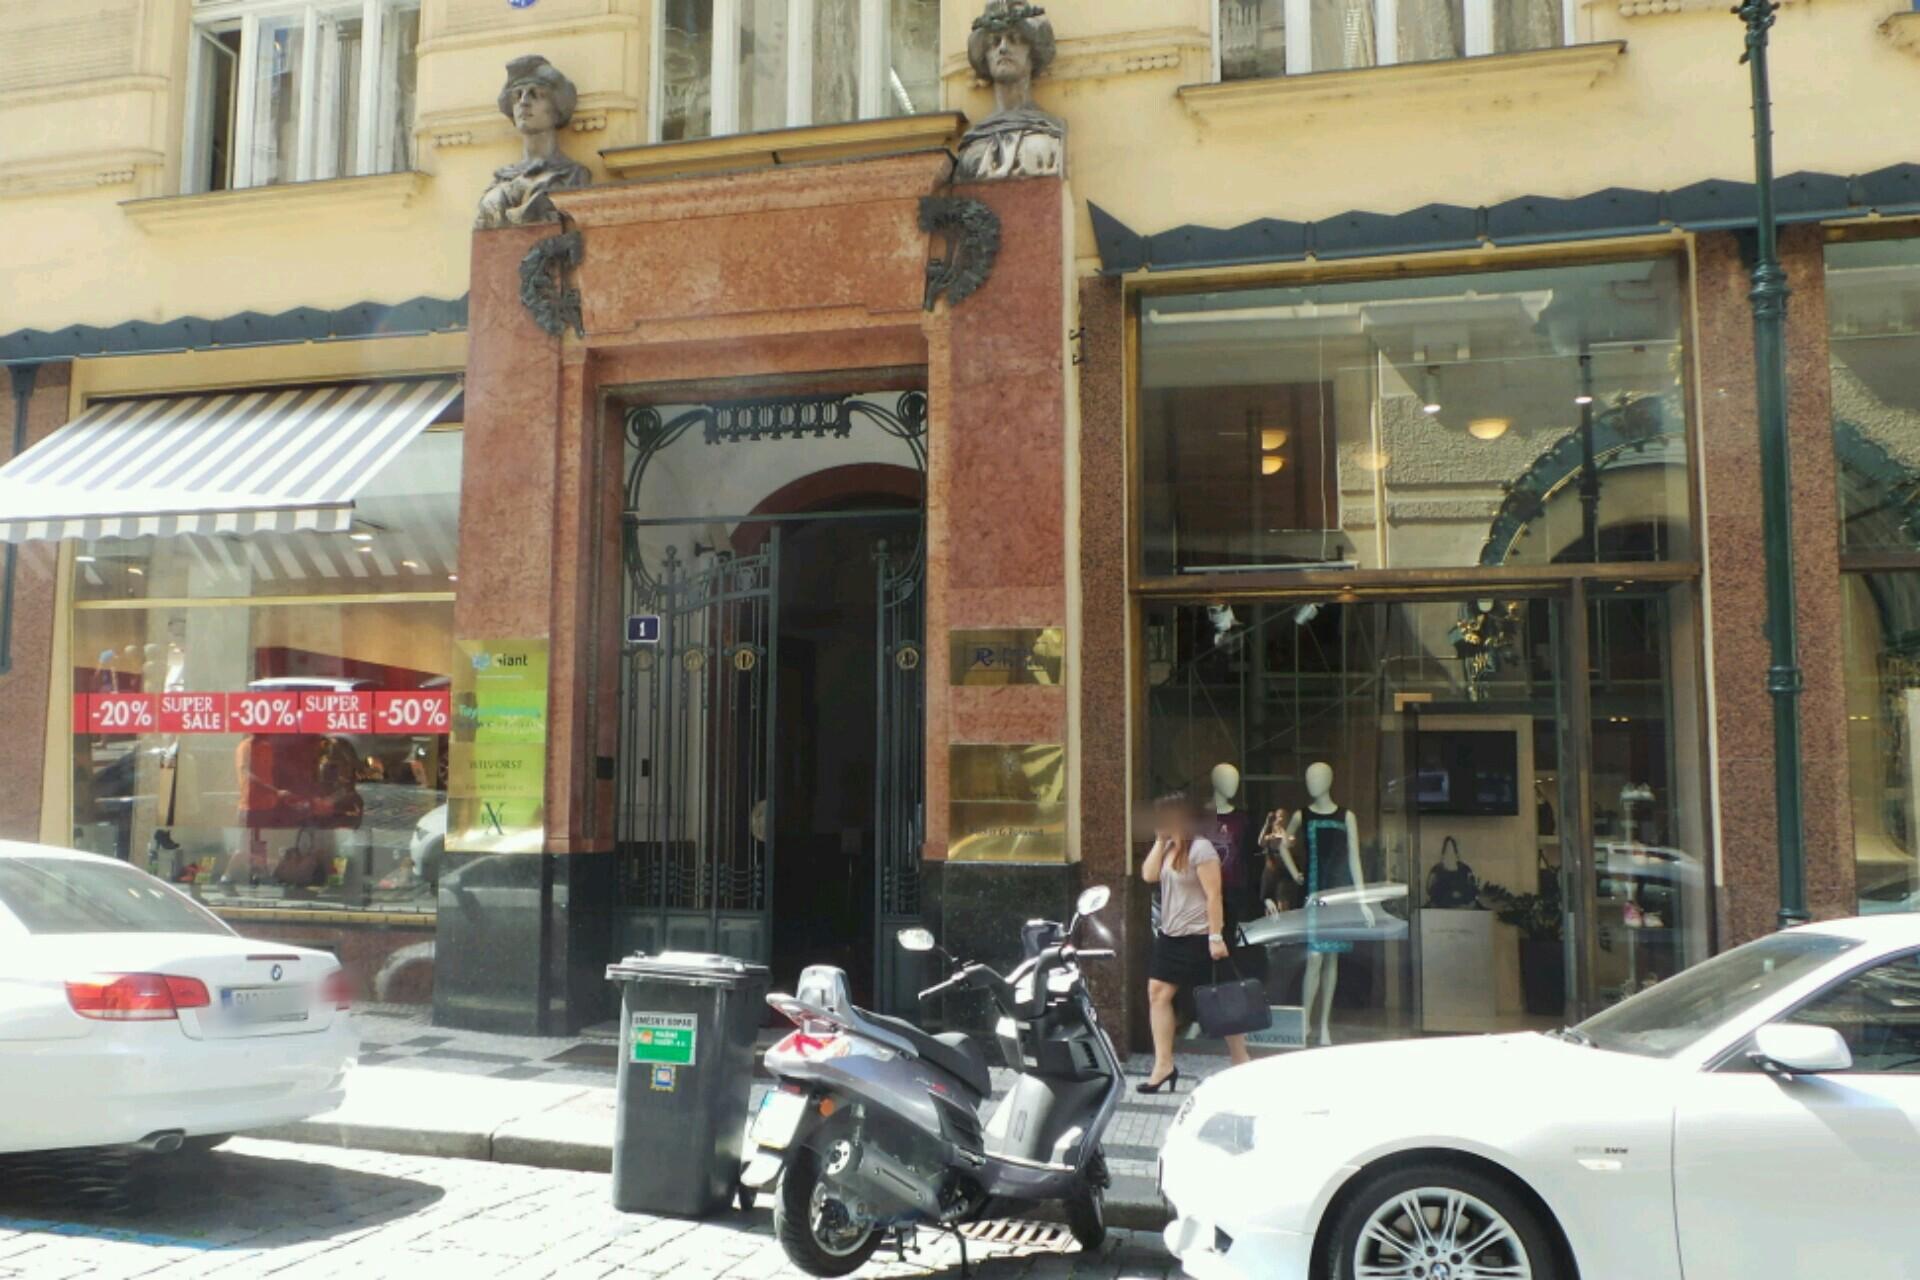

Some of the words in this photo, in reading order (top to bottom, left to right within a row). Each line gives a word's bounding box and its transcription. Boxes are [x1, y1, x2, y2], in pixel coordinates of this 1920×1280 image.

[640, 621, 645, 637] 1
[161, 697, 213, 712] SUPER
[305, 696, 359, 712] SUPER
[378, 699, 446, 726] -50%
[92, 700, 152, 726] -20%
[182, 712, 221, 729] SALE
[231, 700, 295, 726] -30%
[327, 712, 367, 730] SALE
